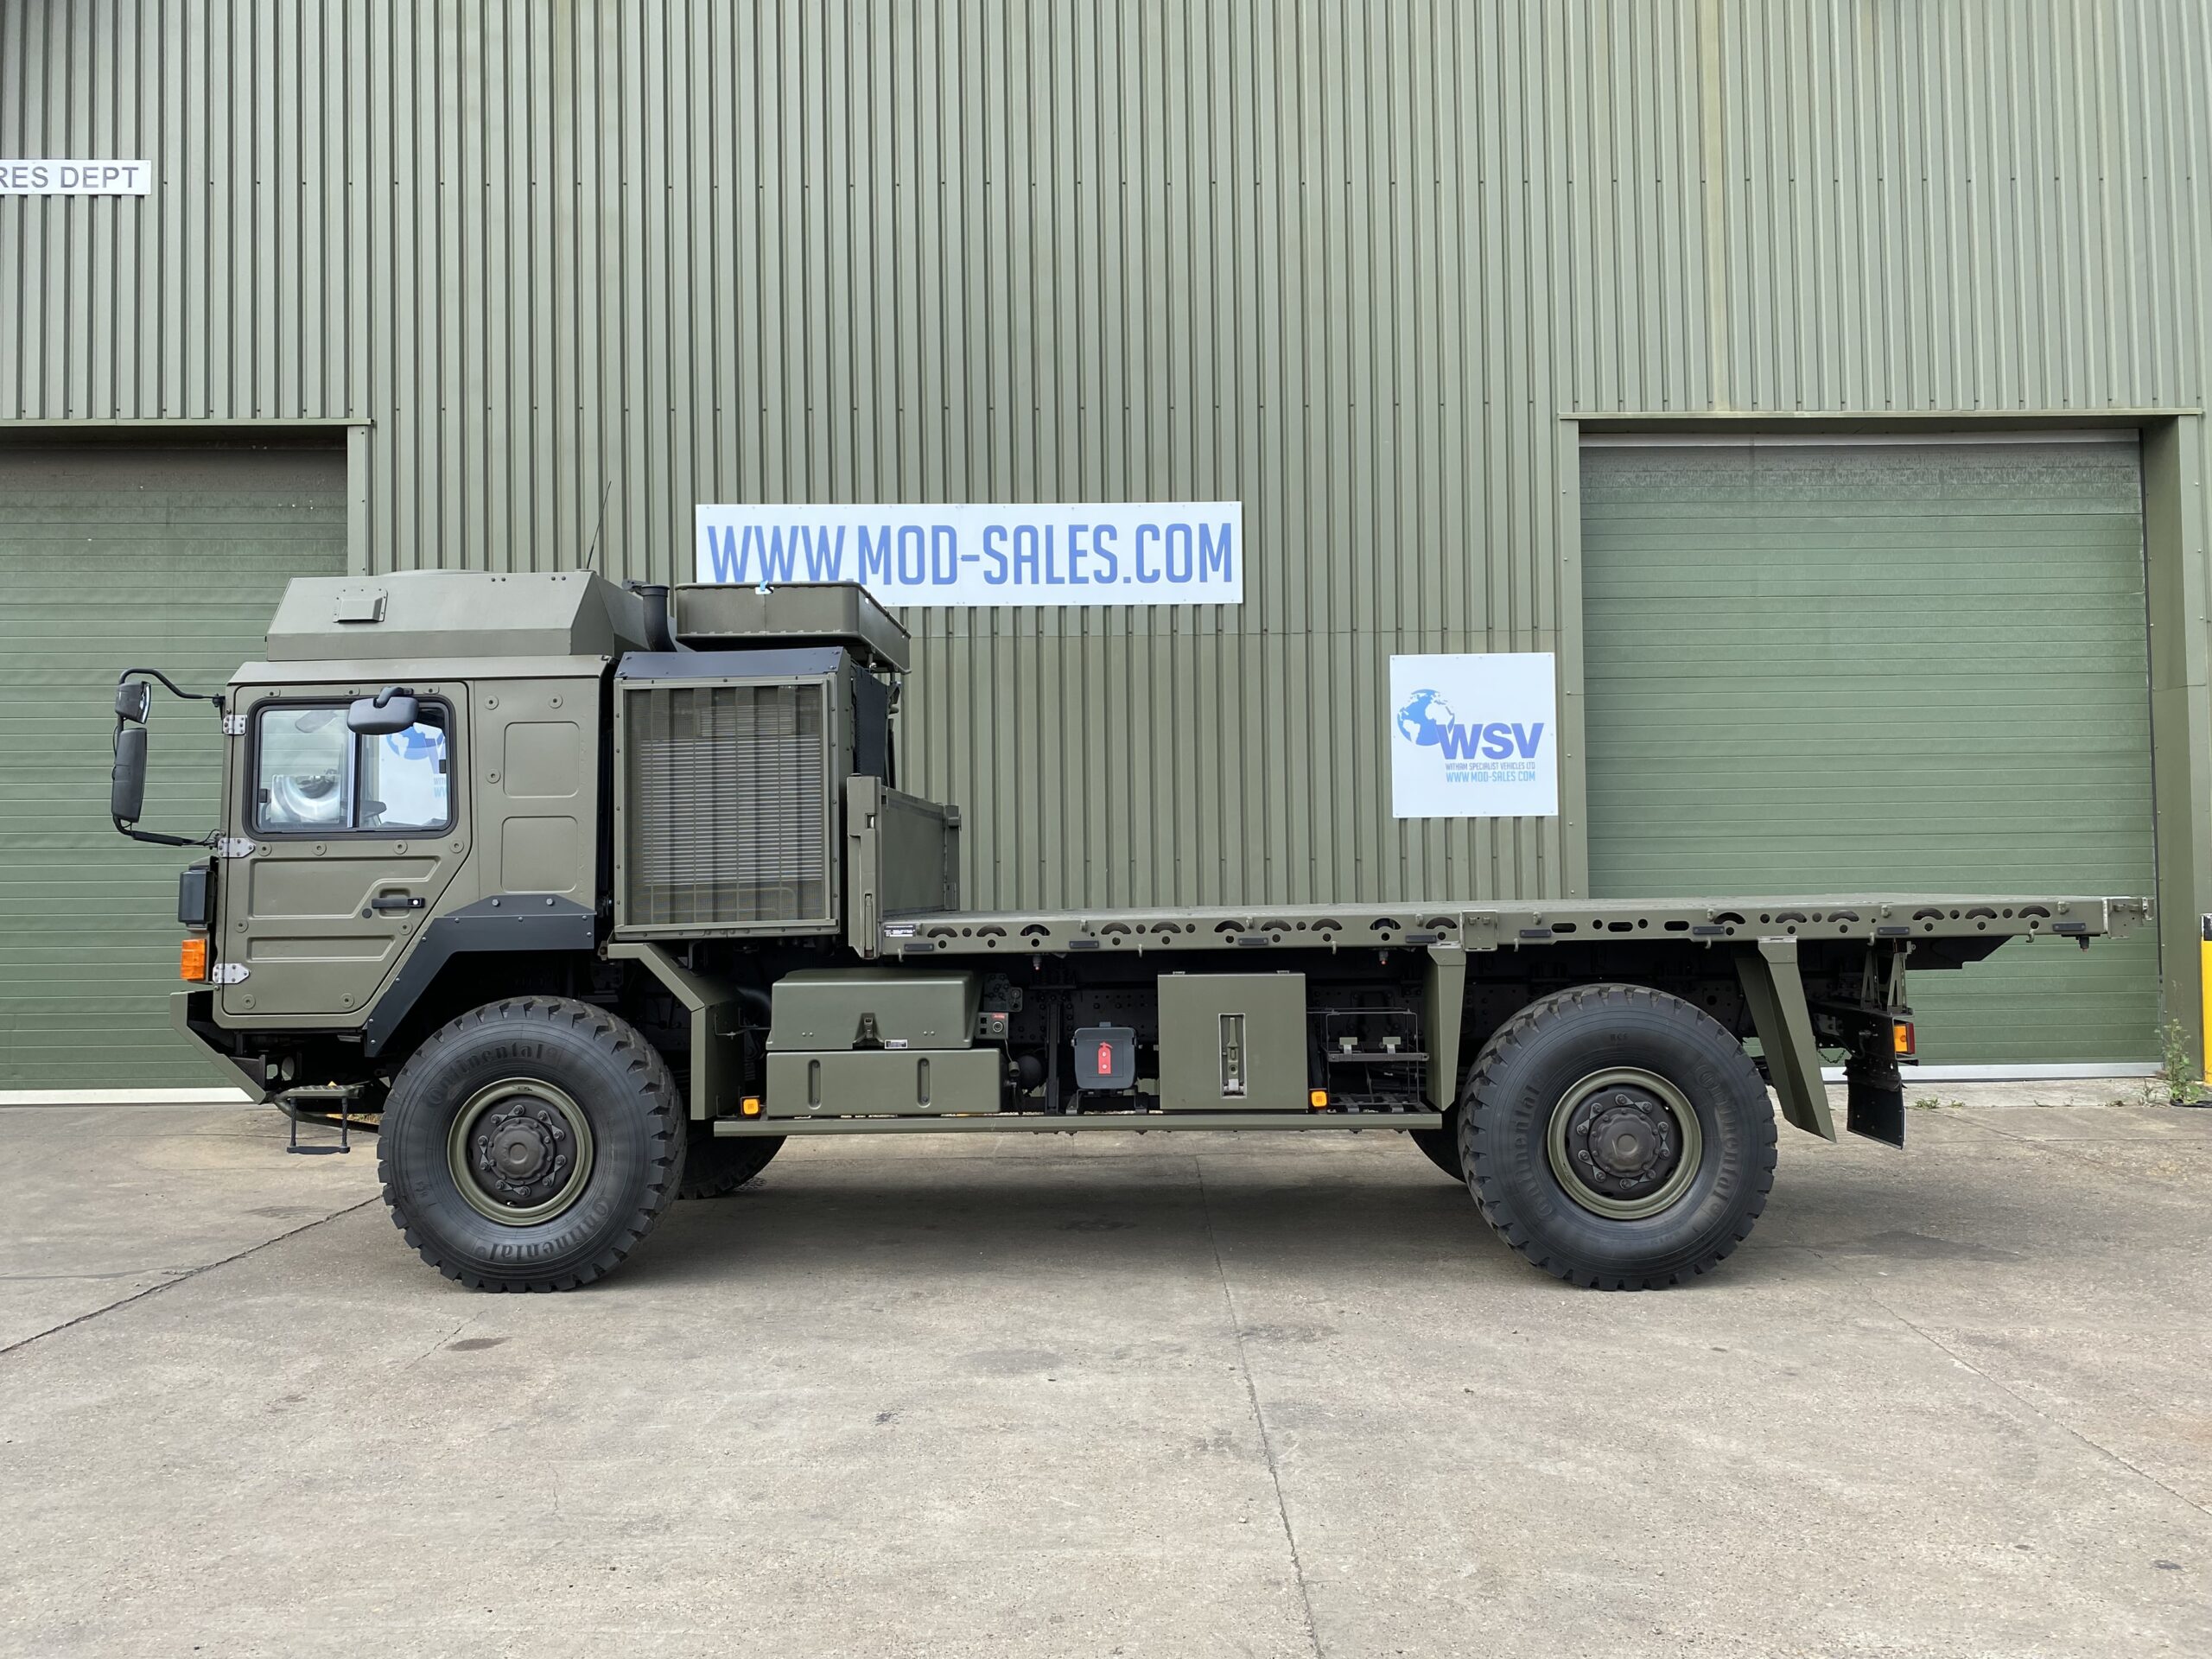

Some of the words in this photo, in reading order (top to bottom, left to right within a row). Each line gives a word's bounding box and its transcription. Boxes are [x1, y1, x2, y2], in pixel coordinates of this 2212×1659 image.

[60, 167, 138, 188] DEPT
[707, 523, 1232, 585] WWW.MOD-SALES.COM
[1435, 722, 1544, 760] WSV
[1446, 771, 1535, 782] WWWMOD-SALESCOM
